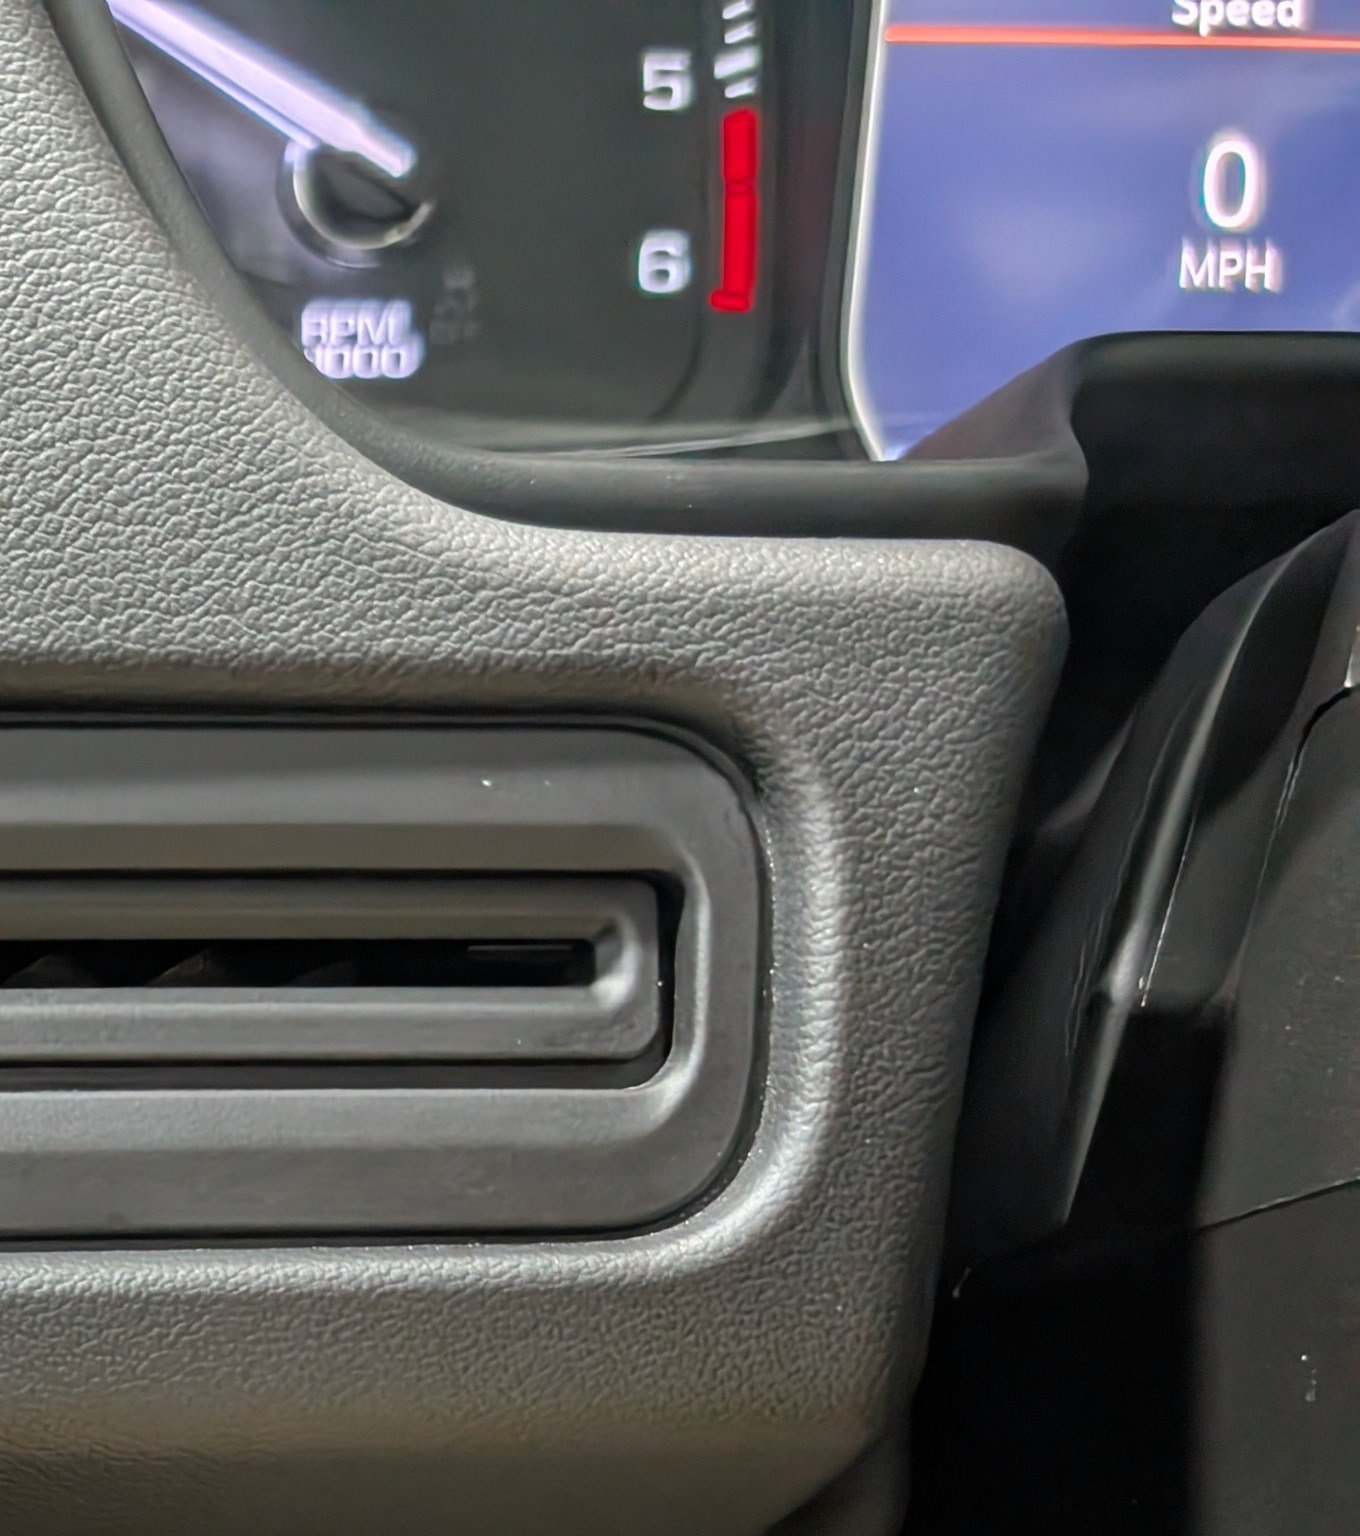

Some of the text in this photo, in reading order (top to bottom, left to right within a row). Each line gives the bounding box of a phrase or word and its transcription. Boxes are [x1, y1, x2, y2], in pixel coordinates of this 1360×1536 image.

[1171, 0, 1304, 36] Speed
[642, 50, 691, 111] 5
[1203, 139, 1259, 228] 0
[638, 229, 691, 293] 6
[1179, 240, 1280, 291] MPH
